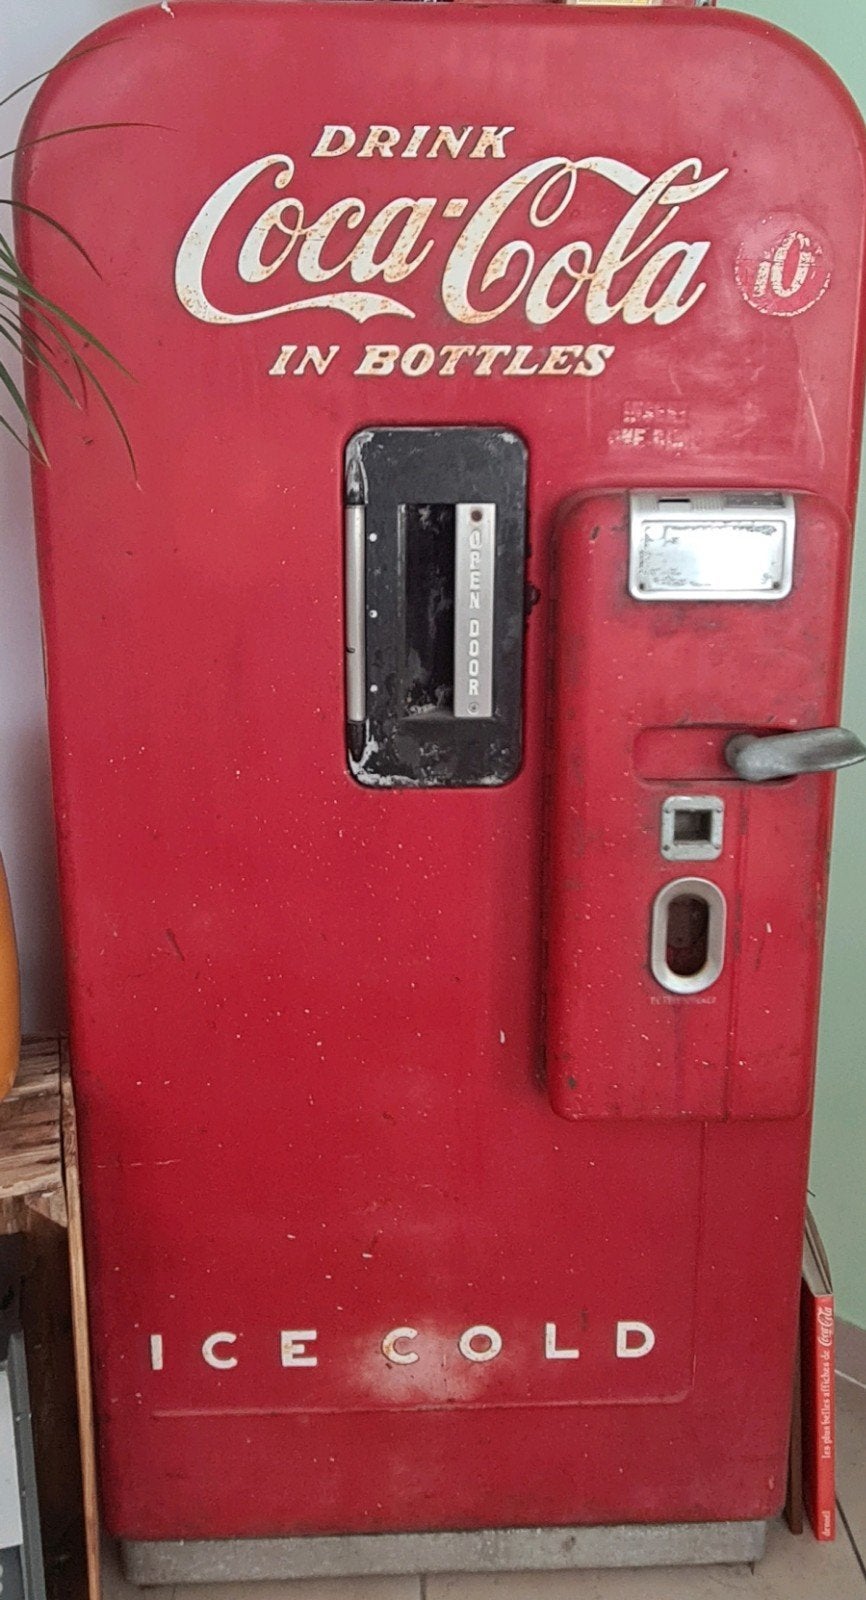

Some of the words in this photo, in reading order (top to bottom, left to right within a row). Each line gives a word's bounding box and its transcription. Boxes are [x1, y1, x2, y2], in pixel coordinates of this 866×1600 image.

[310, 124, 516, 159] DRINK
[173, 153, 730, 326] Coca-Cola
[268, 343, 340, 377] IN
[353, 343, 616, 378] BOTTLES
[468, 529, 483, 610] OPEN
[467, 618, 481, 697] DOOR
[149, 1329, 319, 1371] ICE
[380, 1320, 657, 1365] COLD
[820, 1350, 831, 1360] de
[820, 1361, 831, 1398] affiches
